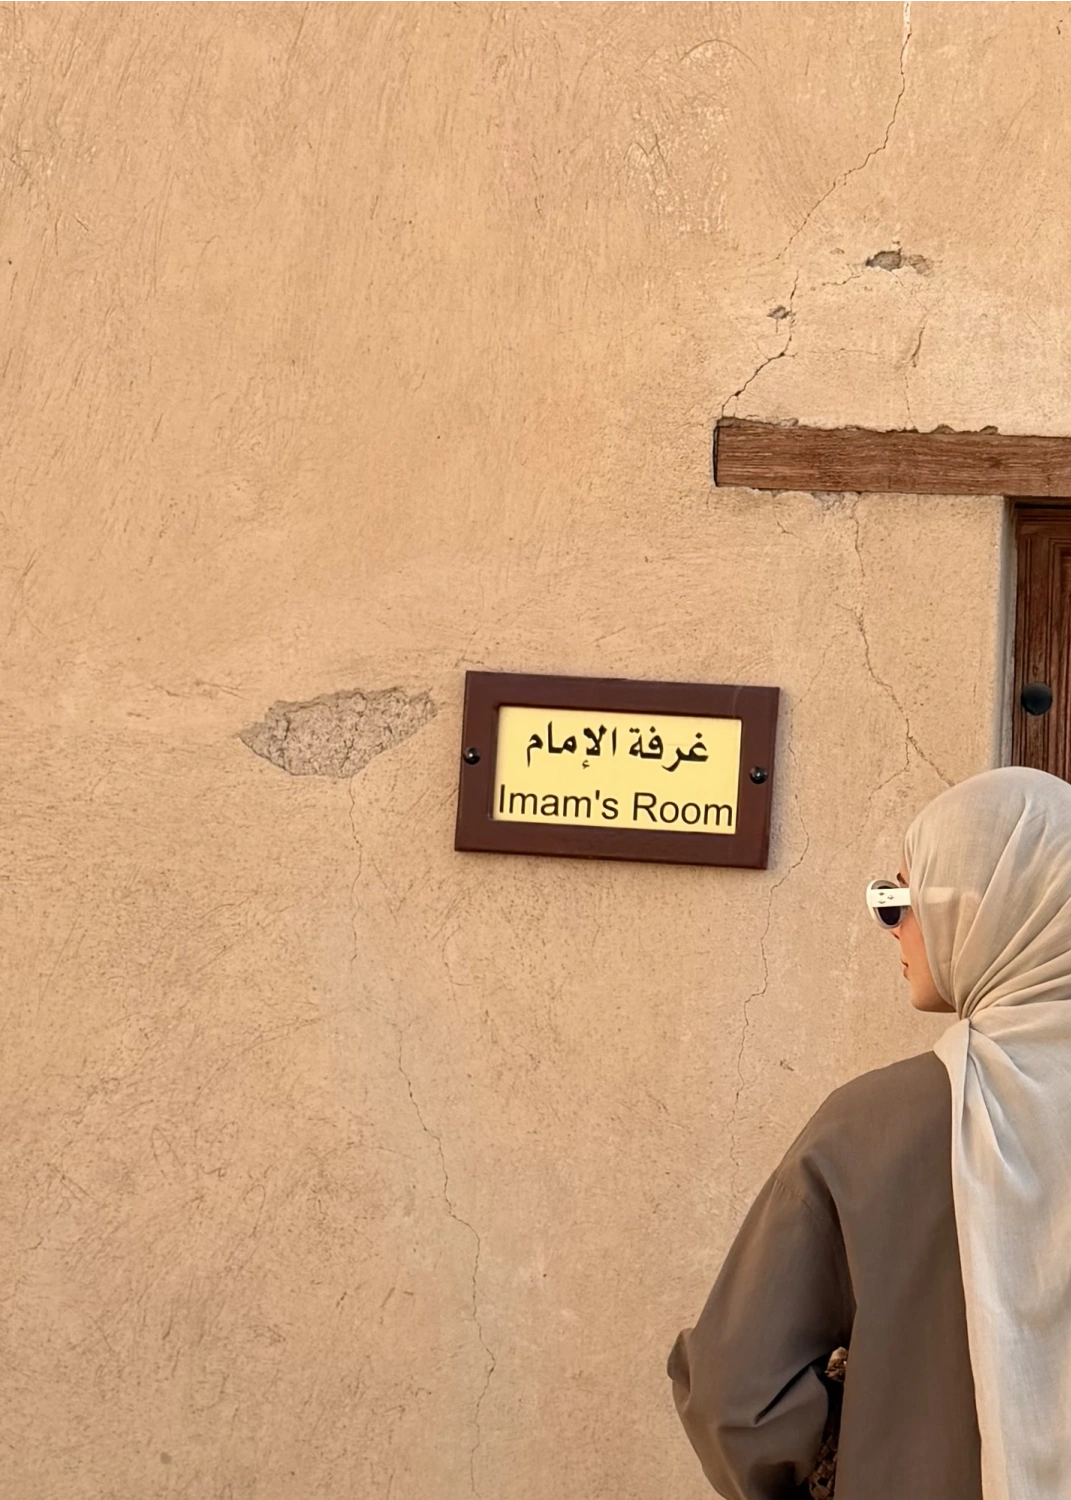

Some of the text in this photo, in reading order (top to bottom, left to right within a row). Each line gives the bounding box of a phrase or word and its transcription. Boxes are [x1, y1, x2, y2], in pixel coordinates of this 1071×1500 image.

[526, 720, 709, 772] غرفة الإمام
[498, 784, 734, 827] Imam's Room
